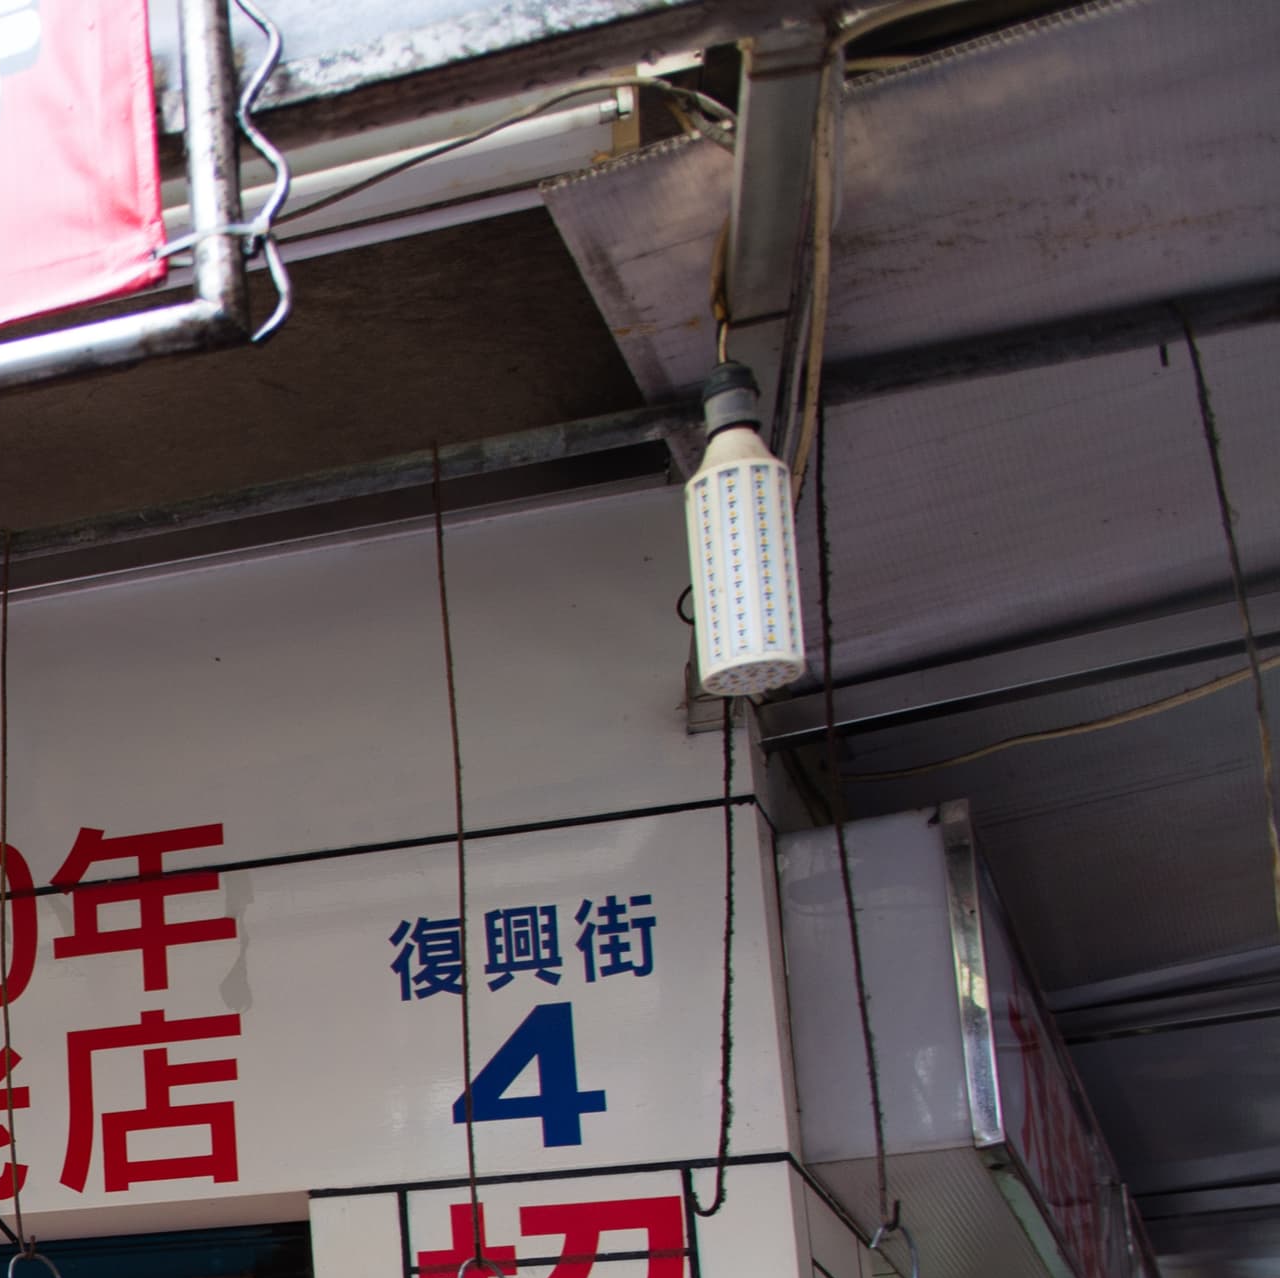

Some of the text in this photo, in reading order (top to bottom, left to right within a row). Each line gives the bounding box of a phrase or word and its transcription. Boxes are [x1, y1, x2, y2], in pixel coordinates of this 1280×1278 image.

[390, 894, 656, 1001] 復興街
[452, 1002, 607, 1148] 4
